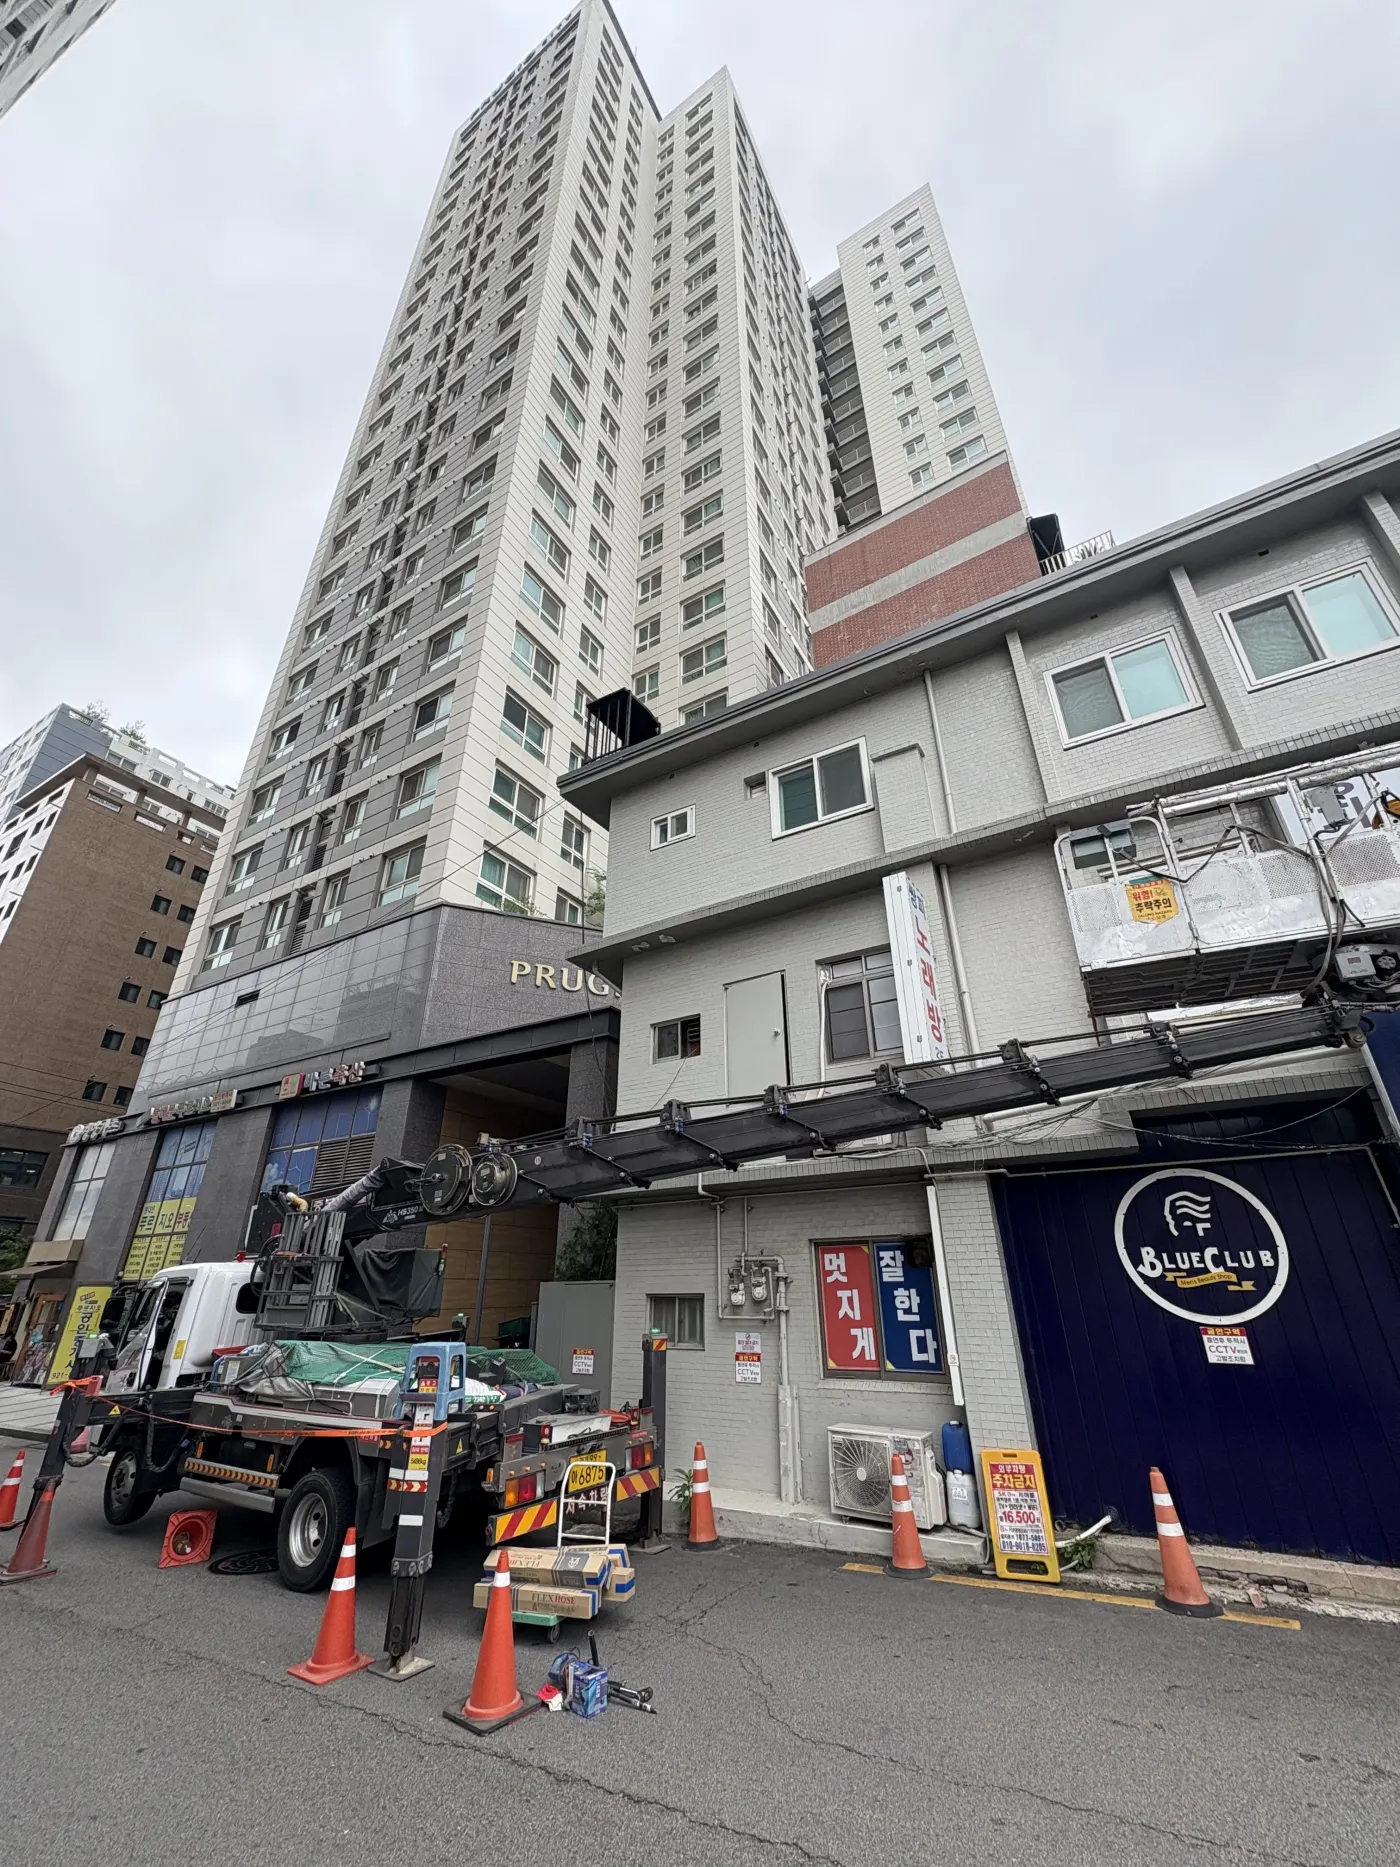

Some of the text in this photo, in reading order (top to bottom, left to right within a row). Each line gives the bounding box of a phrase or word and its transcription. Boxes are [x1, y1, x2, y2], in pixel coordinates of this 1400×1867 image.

[1133, 890, 1153, 901] 위험!
[1135, 898, 1172, 912] 추락주의
[511, 960, 620, 997] PRUG
[1198, 1275, 1216, 1284] Beauty
[1217, 1273, 1233, 1281] Shop
[824, 1252, 876, 1360] 멋지게
[879, 1250, 938, 1363] 잘한다
[1208, 1327, 1240, 1336] 금연구역
[1209, 1346, 1237, 1354] CCTV
[998, 1465, 1026, 1474] 외부차량
[992, 1474, 1036, 1489] 주차금지
[1002, 1510, 1036, 1524] 16,500
[531, 1592, 576, 1605] FLEXHOSE
